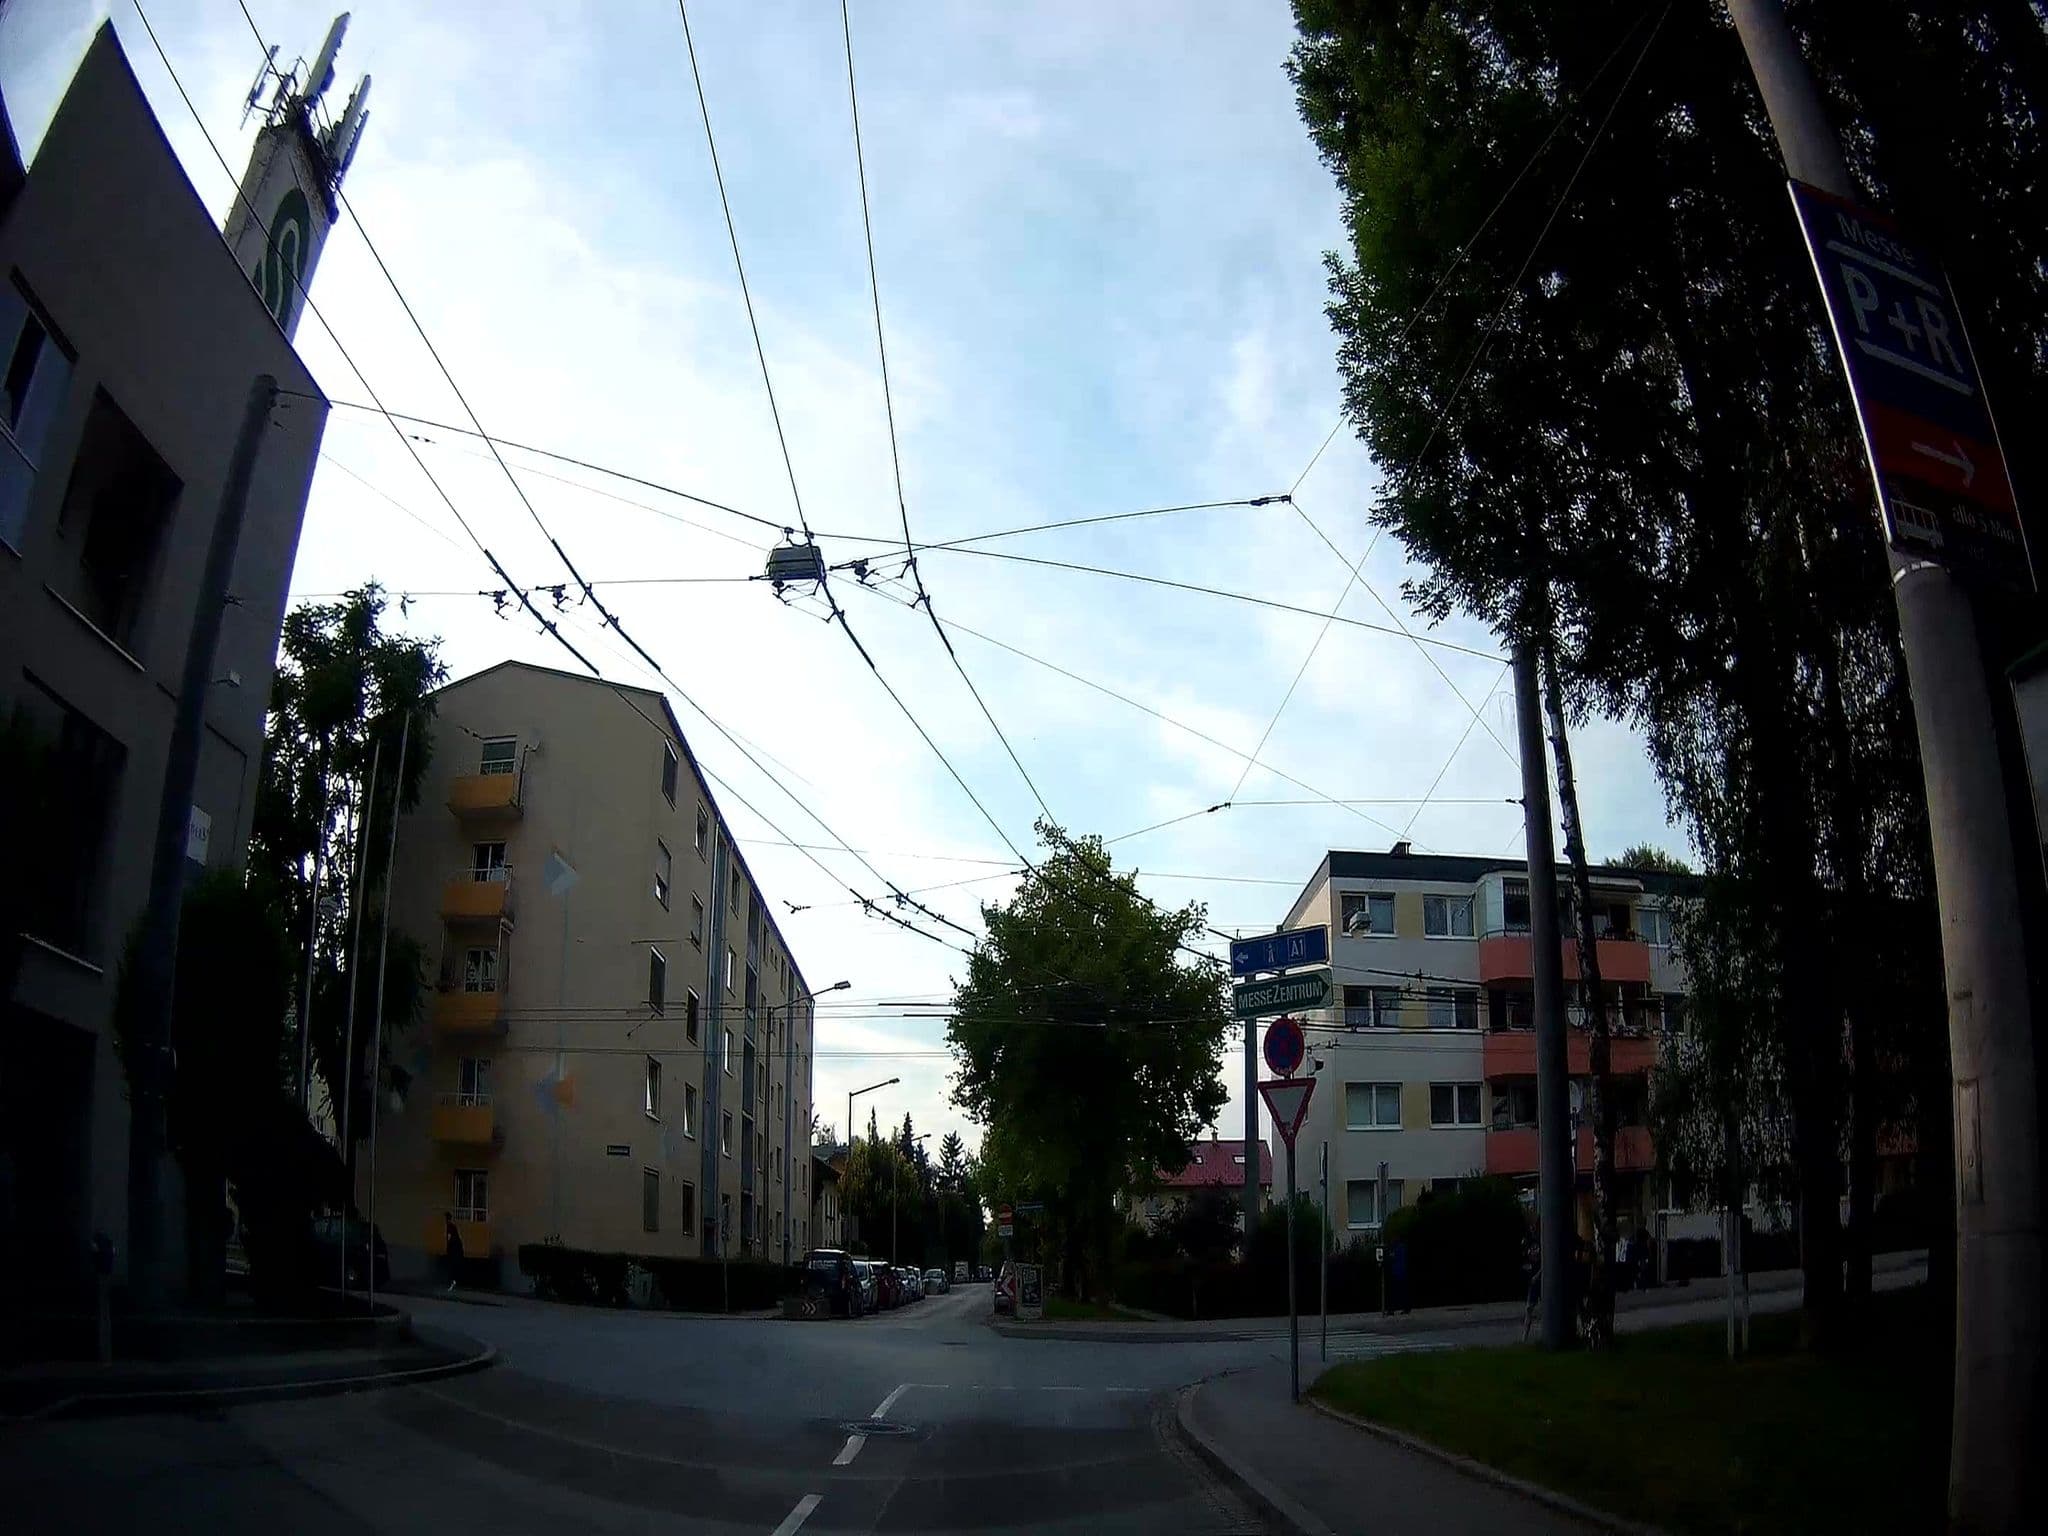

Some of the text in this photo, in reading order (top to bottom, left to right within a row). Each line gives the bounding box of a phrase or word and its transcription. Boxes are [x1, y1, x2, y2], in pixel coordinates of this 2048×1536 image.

[1836, 211, 1916, 268] Messe
[1840, 260, 1964, 375] P+R
[1290, 938, 1304, 957] A1
[1238, 980, 1324, 1009] MESSEZENTRUM
